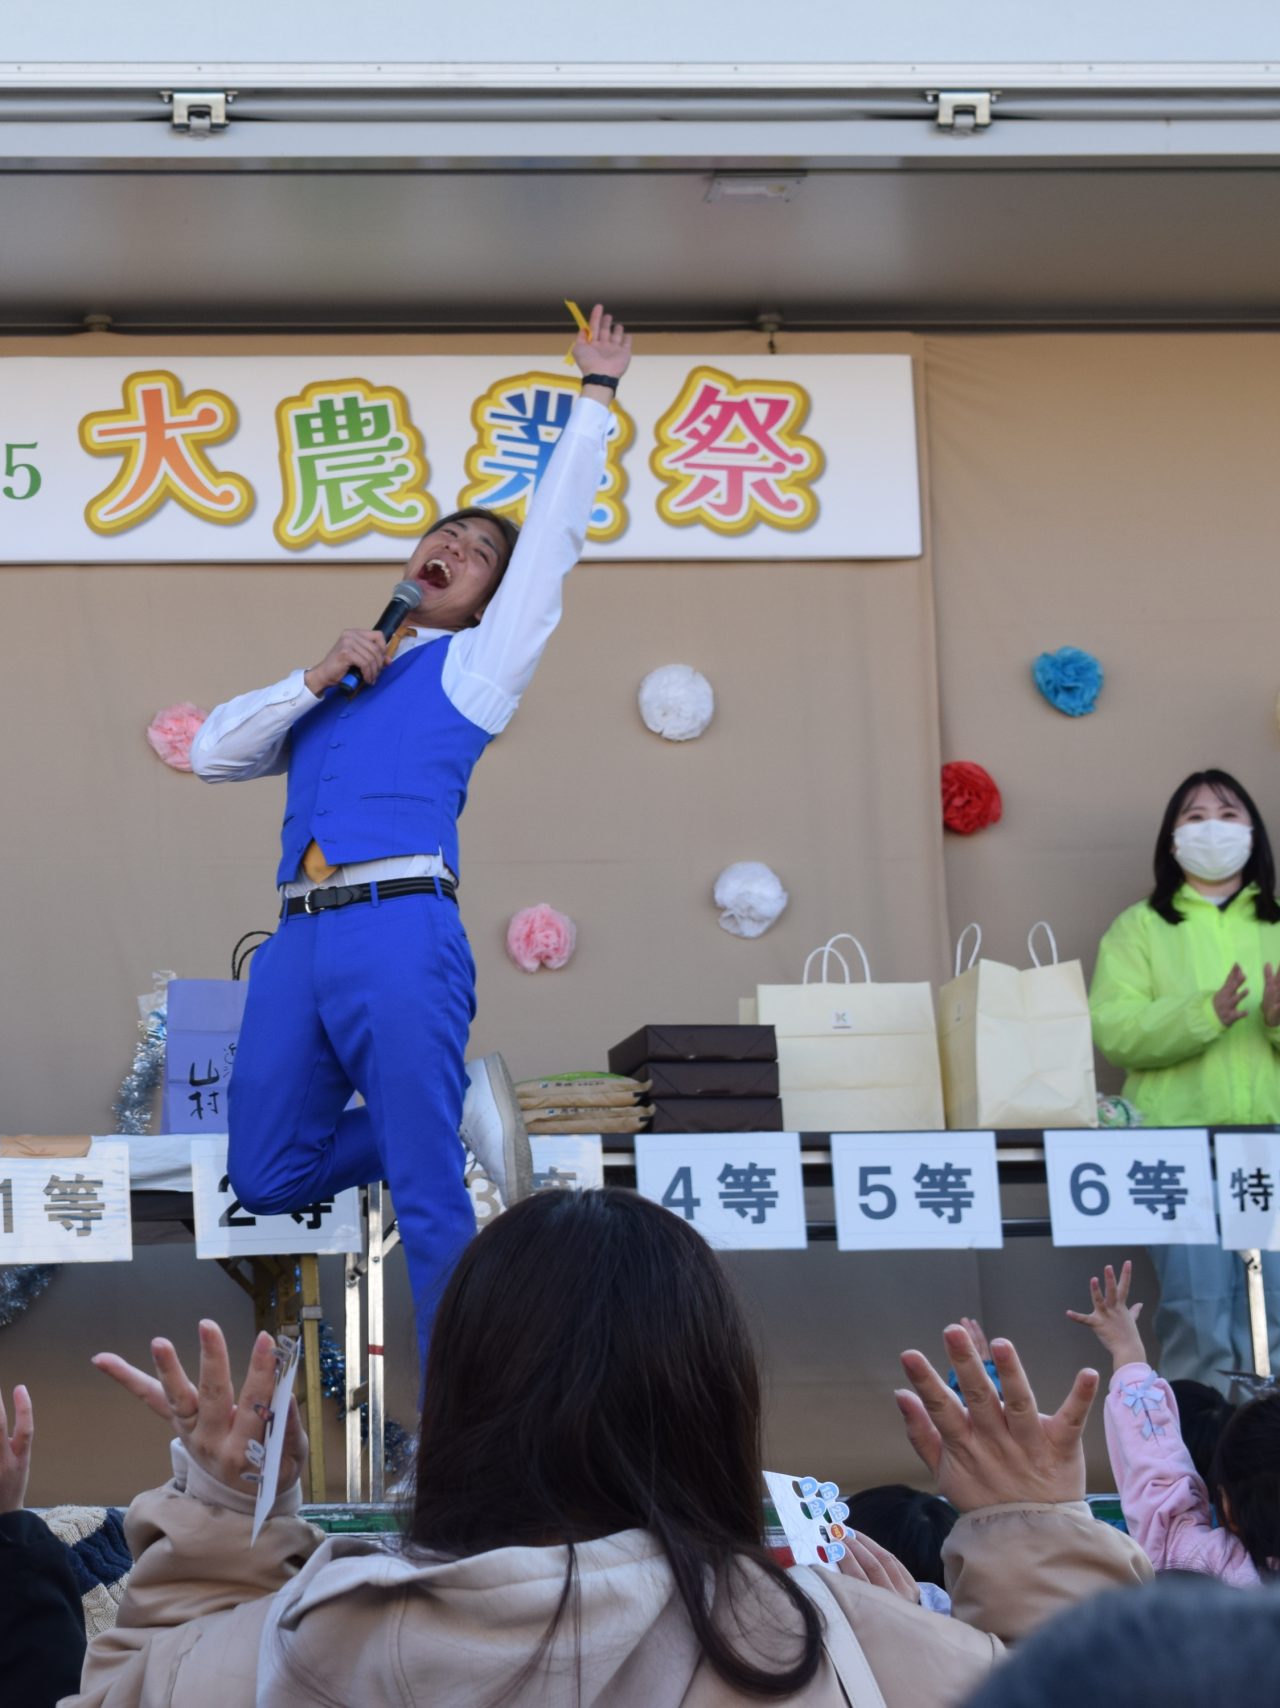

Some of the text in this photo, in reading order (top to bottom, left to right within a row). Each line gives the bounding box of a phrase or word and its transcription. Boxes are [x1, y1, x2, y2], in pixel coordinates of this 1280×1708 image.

[660, 1161, 779, 1225] 4等
[857, 1161, 976, 1225] 5等
[1067, 1159, 1189, 1221] 6等
